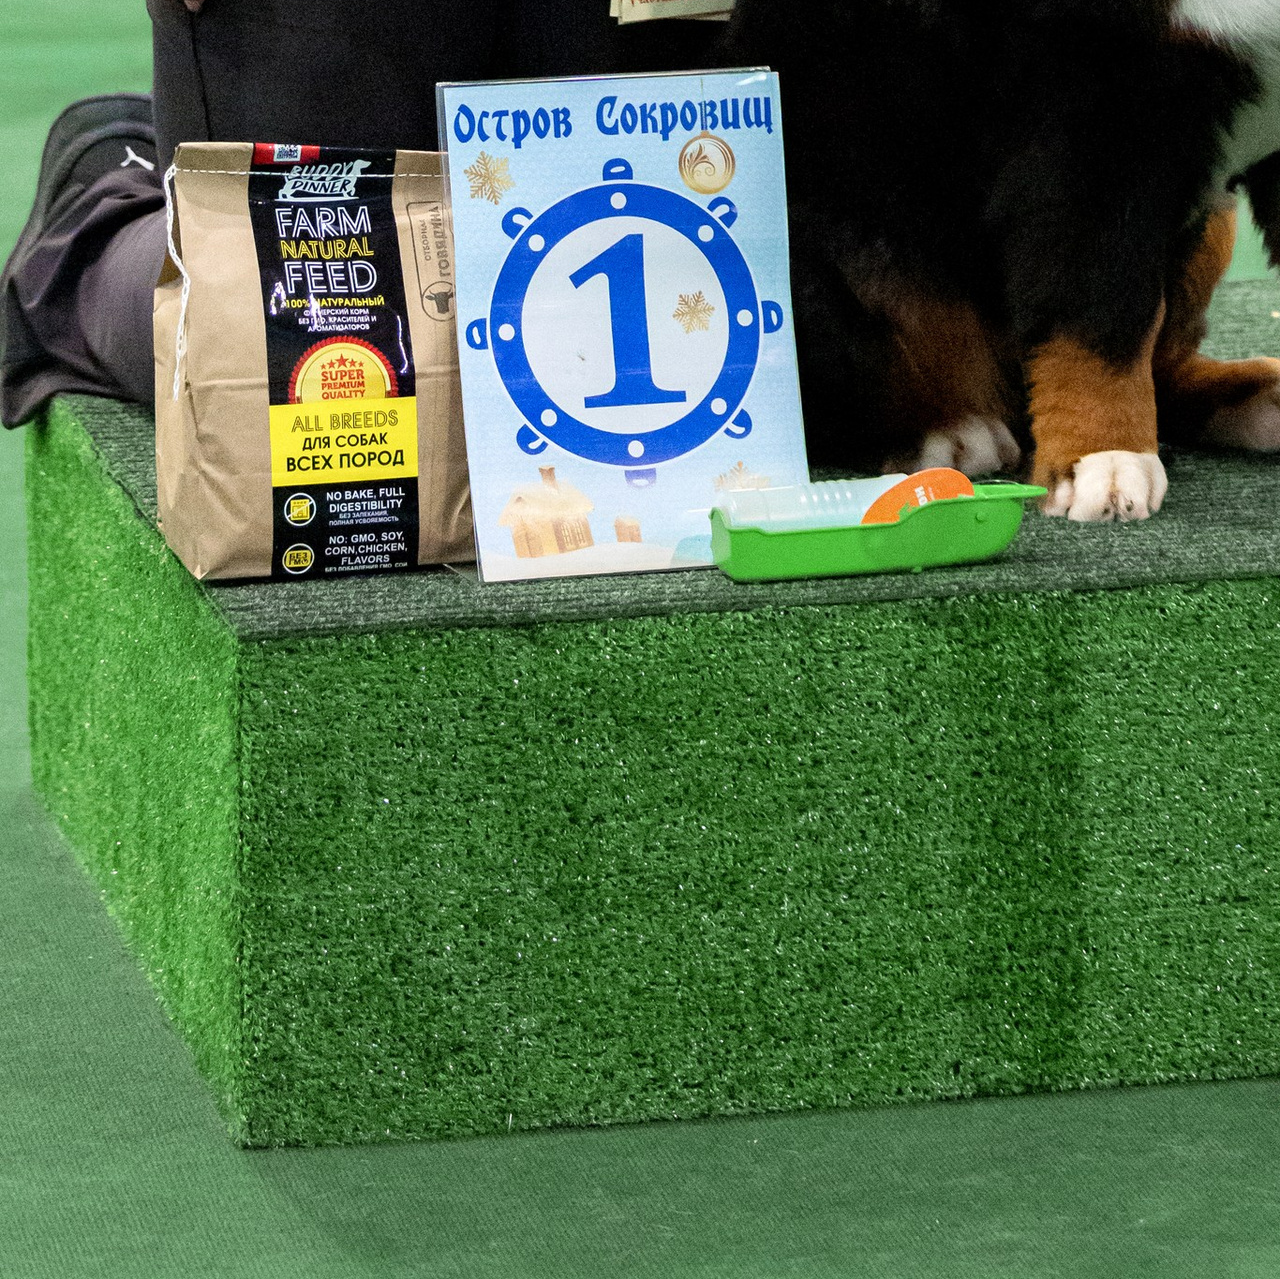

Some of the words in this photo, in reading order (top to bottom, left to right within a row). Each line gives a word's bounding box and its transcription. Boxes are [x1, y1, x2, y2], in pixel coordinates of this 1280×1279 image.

[453, 103, 573, 149] Остров
[596, 95, 773, 143] Сокровищ
[288, 161, 354, 181] BUDDY
[291, 179, 352, 193] DINNER
[275, 206, 372, 238] FARM
[280, 237, 375, 259] NATURAL
[284, 260, 377, 293] FEED
[286, 299, 310, 308] 100%
[303, 308, 349, 316] ФМЕРСКИЙ
[568, 233, 687, 409] 1
[321, 369, 365, 381] SUPER
[321, 381, 365, 390] PREMIUM
[321, 390, 366, 400] QUALITY
[291, 415, 323, 432] ALL
[330, 409, 398, 430] BREEDS
[302, 436, 331, 451] ДЛЯ
[335, 432, 388, 448] СОБАК
[286, 454, 333, 472] ВСЕХ
[340, 449, 404, 468] ПОРОД
[326, 491, 342, 501] NO
[345, 489, 376, 500] BAKE,
[379, 487, 405, 497] FULL
[329, 499, 403, 513] DIGESTIBILITY
[329, 535, 348, 545] NO:
[350, 533, 378, 543] GMO,
[381, 531, 405, 541] SOY,
[341, 554, 390, 566] FLAVORS
